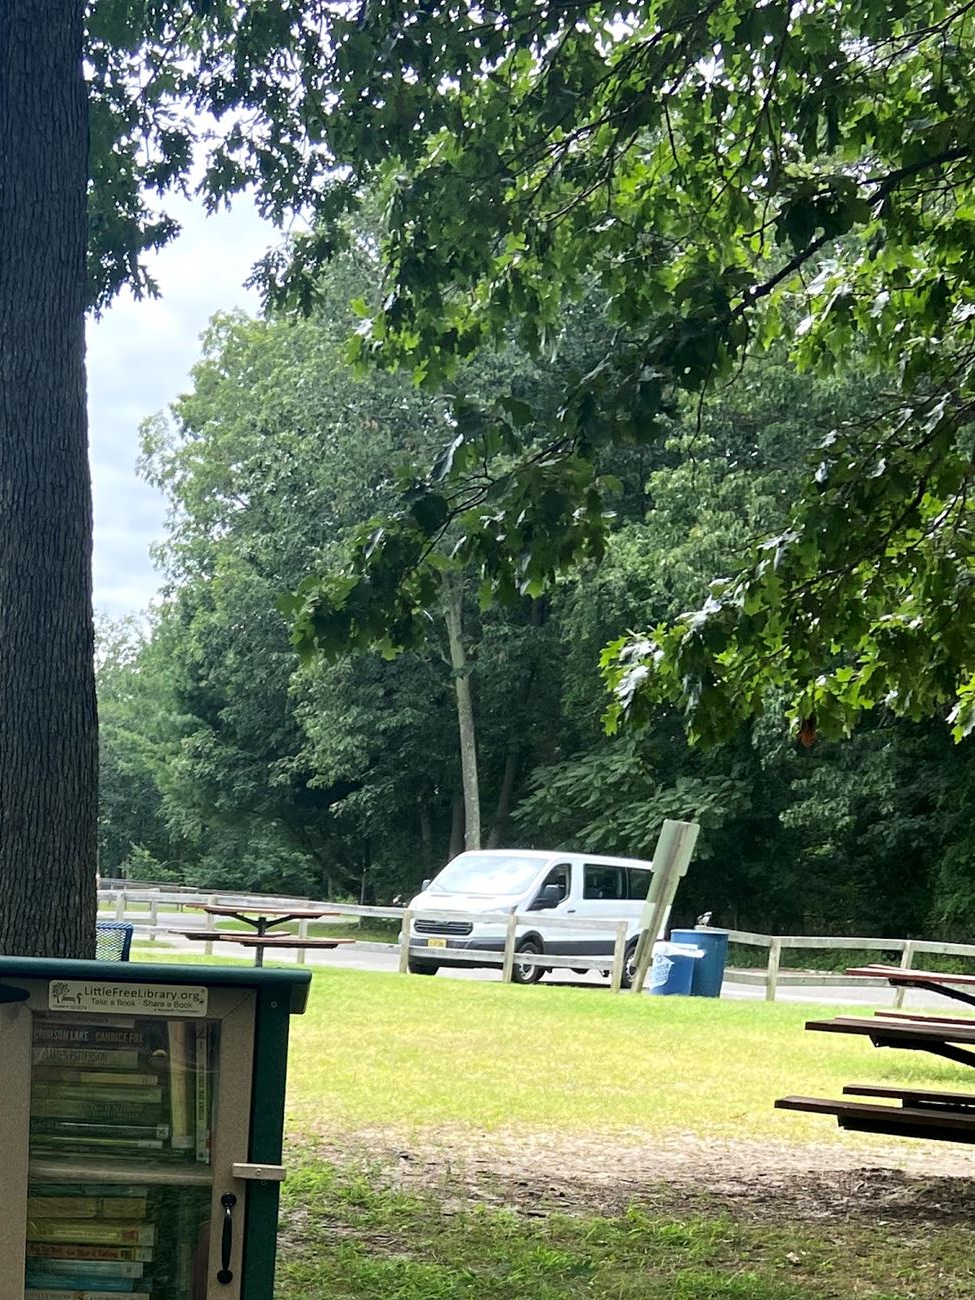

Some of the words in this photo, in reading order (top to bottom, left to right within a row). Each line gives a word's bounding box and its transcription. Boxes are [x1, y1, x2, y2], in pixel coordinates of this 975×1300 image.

[84, 986, 200, 1002] LittleFreeLibrary.org
[91, 997, 108, 1006] Take
[117, 998, 136, 1007] Book
[143, 999, 165, 1008] Share
[173, 1000, 193, 1009] Book
